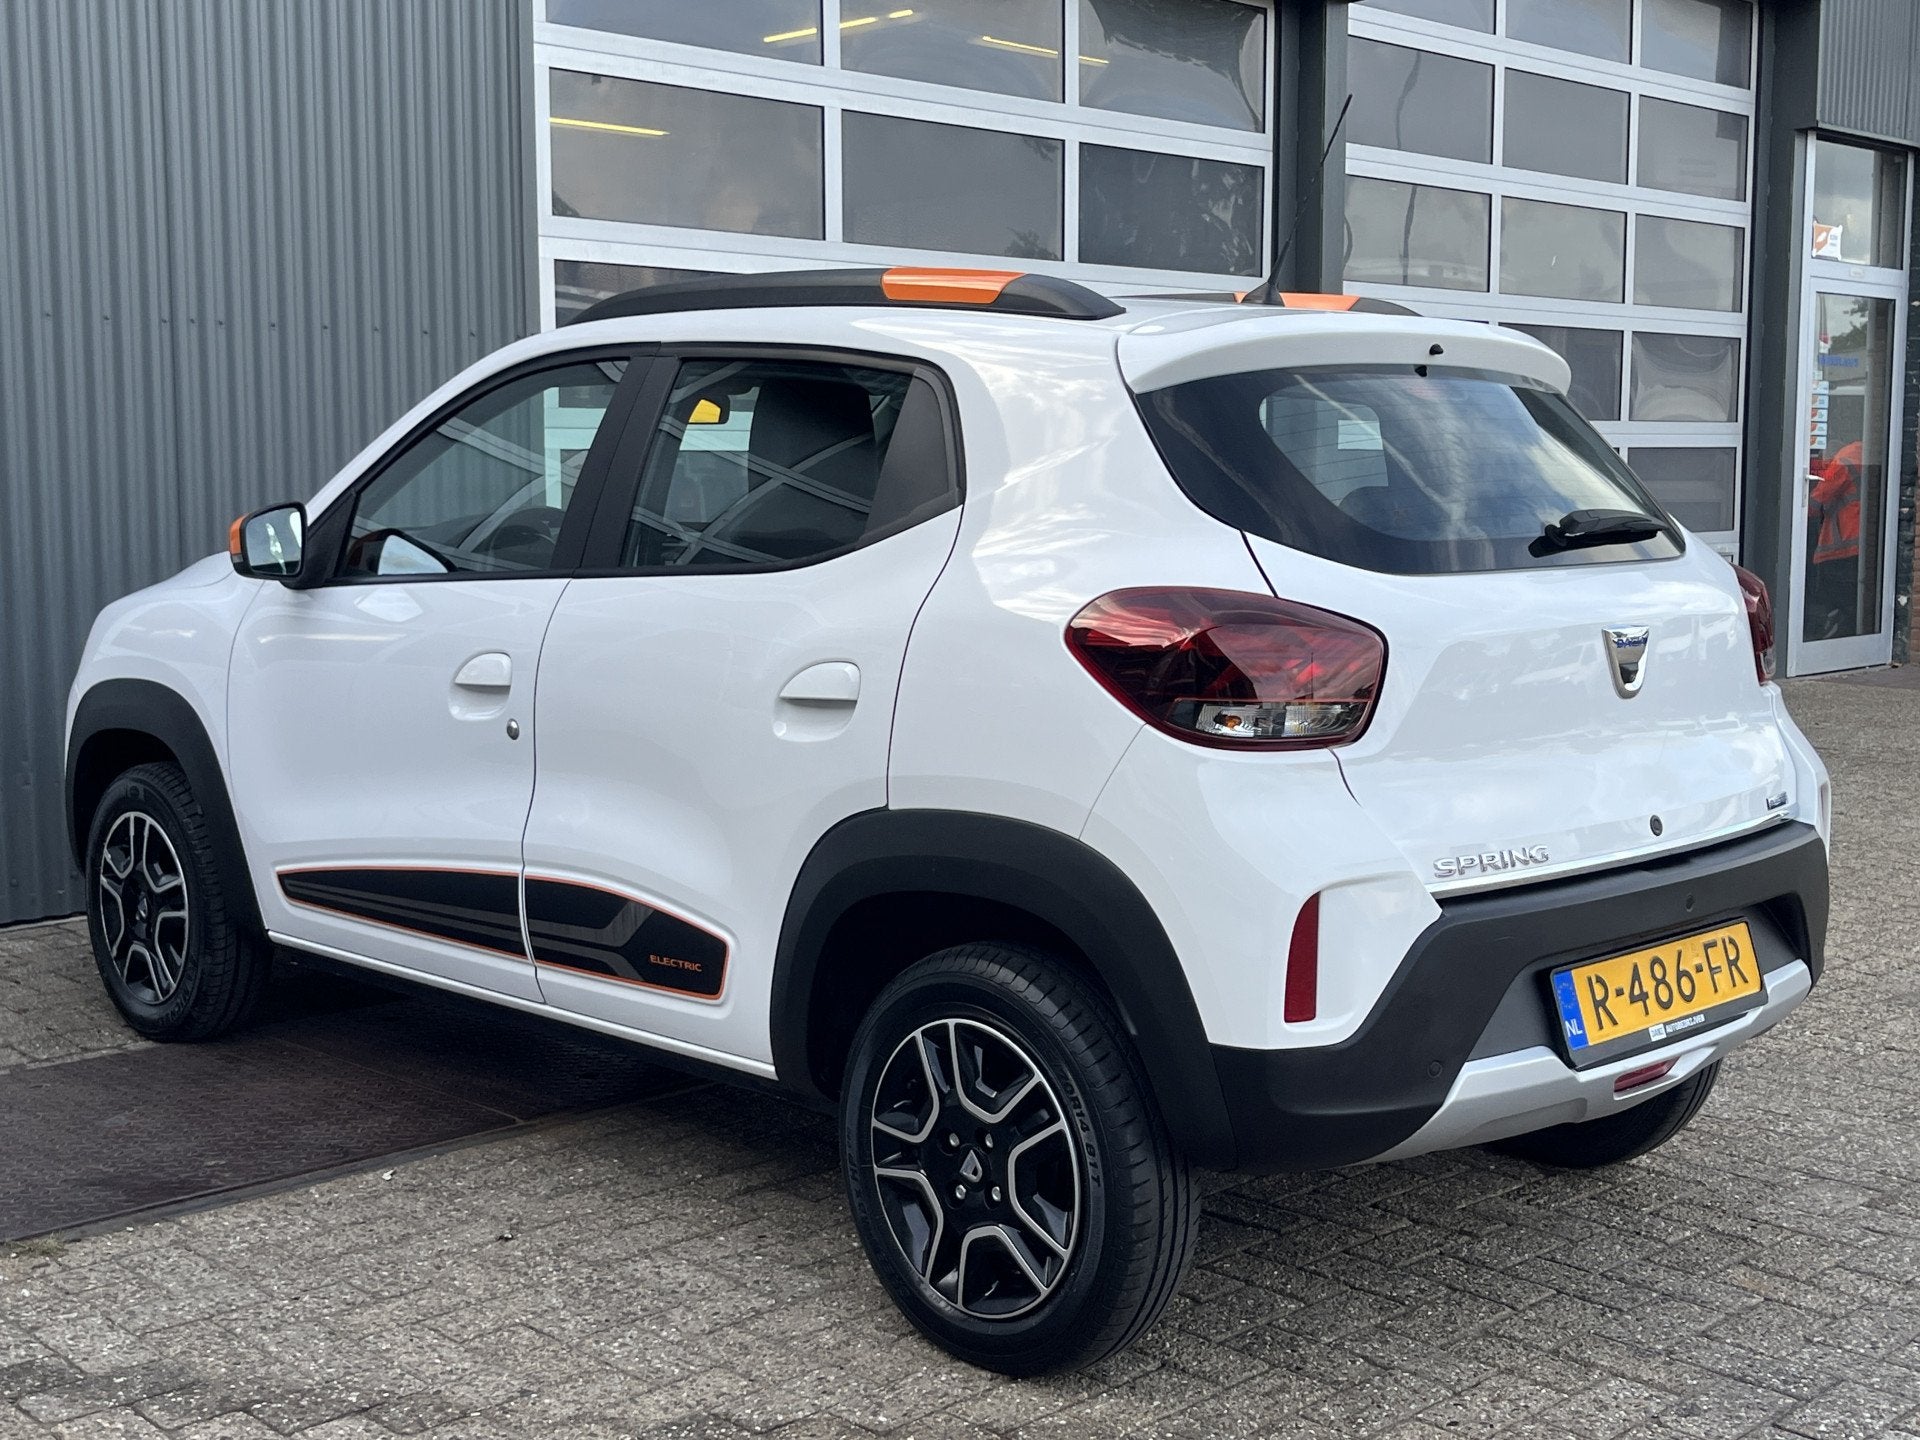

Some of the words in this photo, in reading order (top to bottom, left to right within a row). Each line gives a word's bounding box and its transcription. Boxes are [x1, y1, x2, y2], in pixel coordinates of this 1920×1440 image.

[1434, 844, 1550, 879] SPRING
[649, 954, 703, 972] ELECTRIC
[1587, 935, 1749, 1031] R-486-FR
[1565, 1018, 1583, 1037] NL
